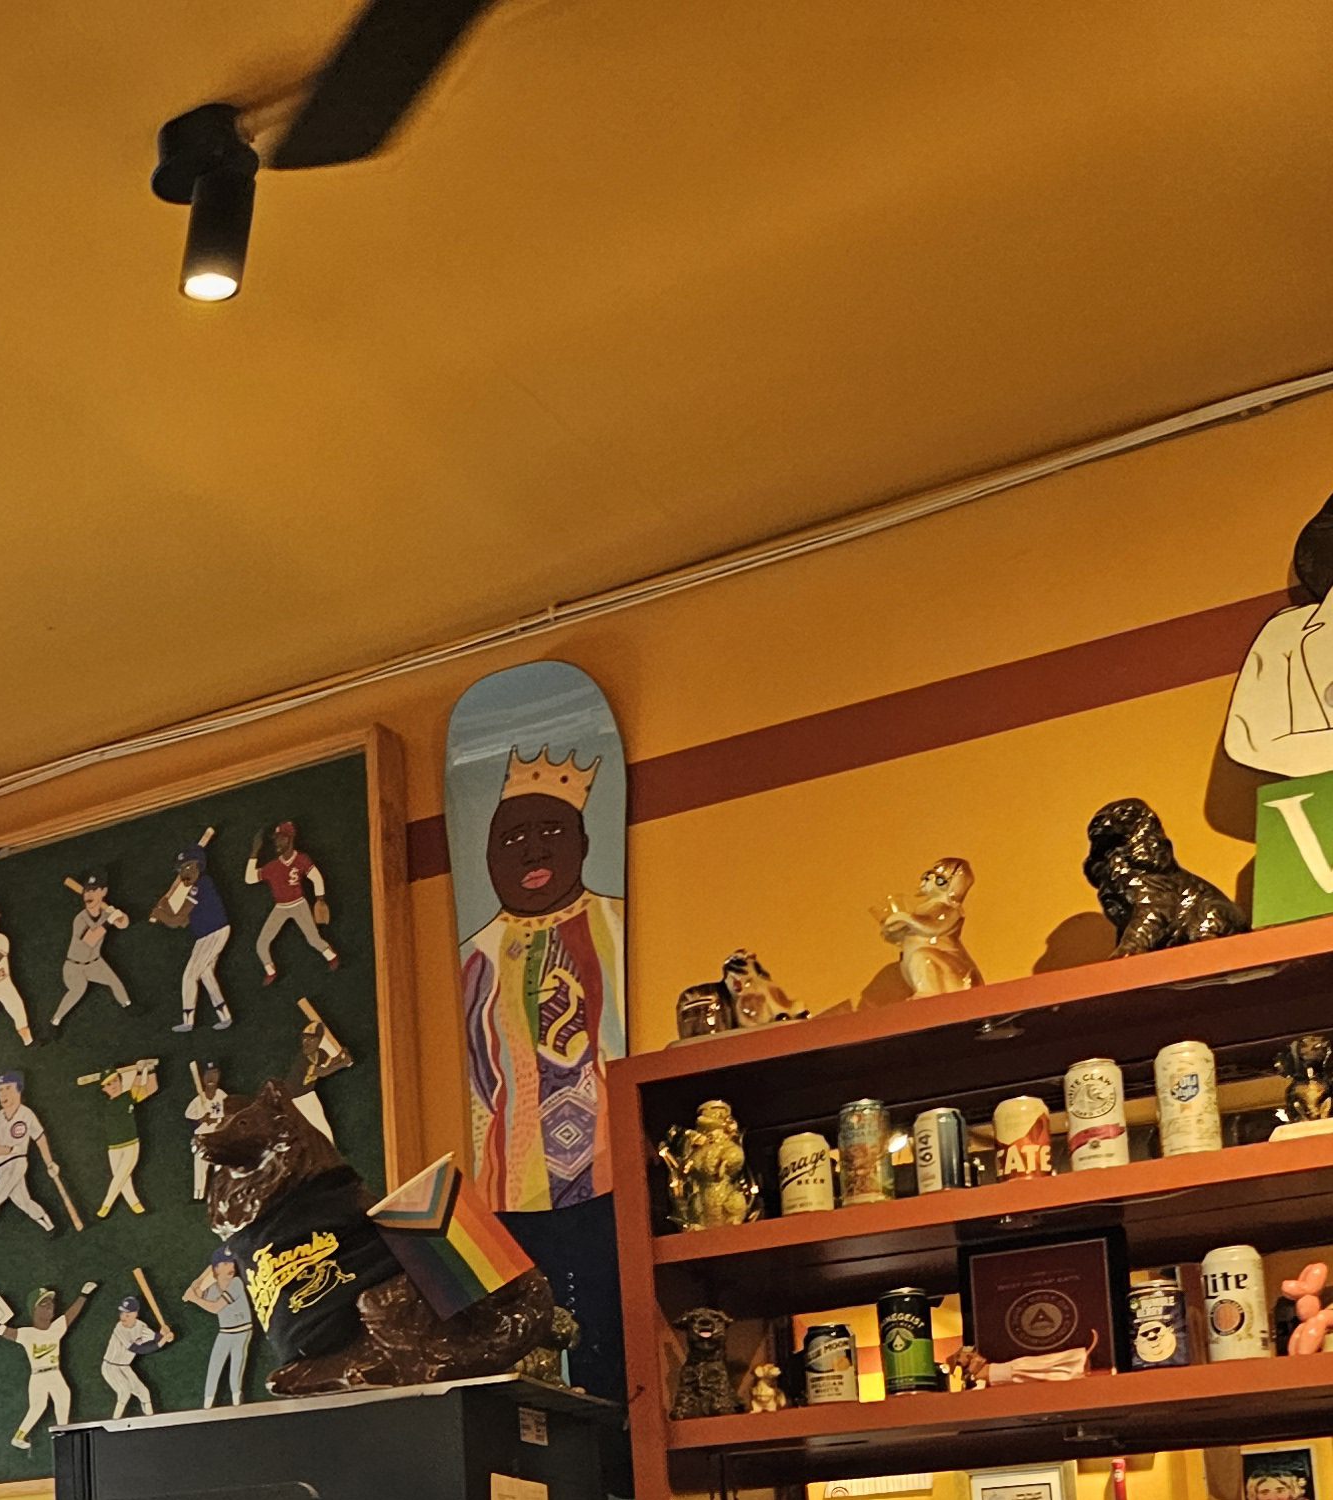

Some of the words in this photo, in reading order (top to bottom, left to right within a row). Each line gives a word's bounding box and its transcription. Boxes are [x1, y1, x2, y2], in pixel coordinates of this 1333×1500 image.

[918, 1128, 937, 1169] (614)
[780, 1149, 827, 1182] arage
[1201, 1271, 1249, 1300] Lite
